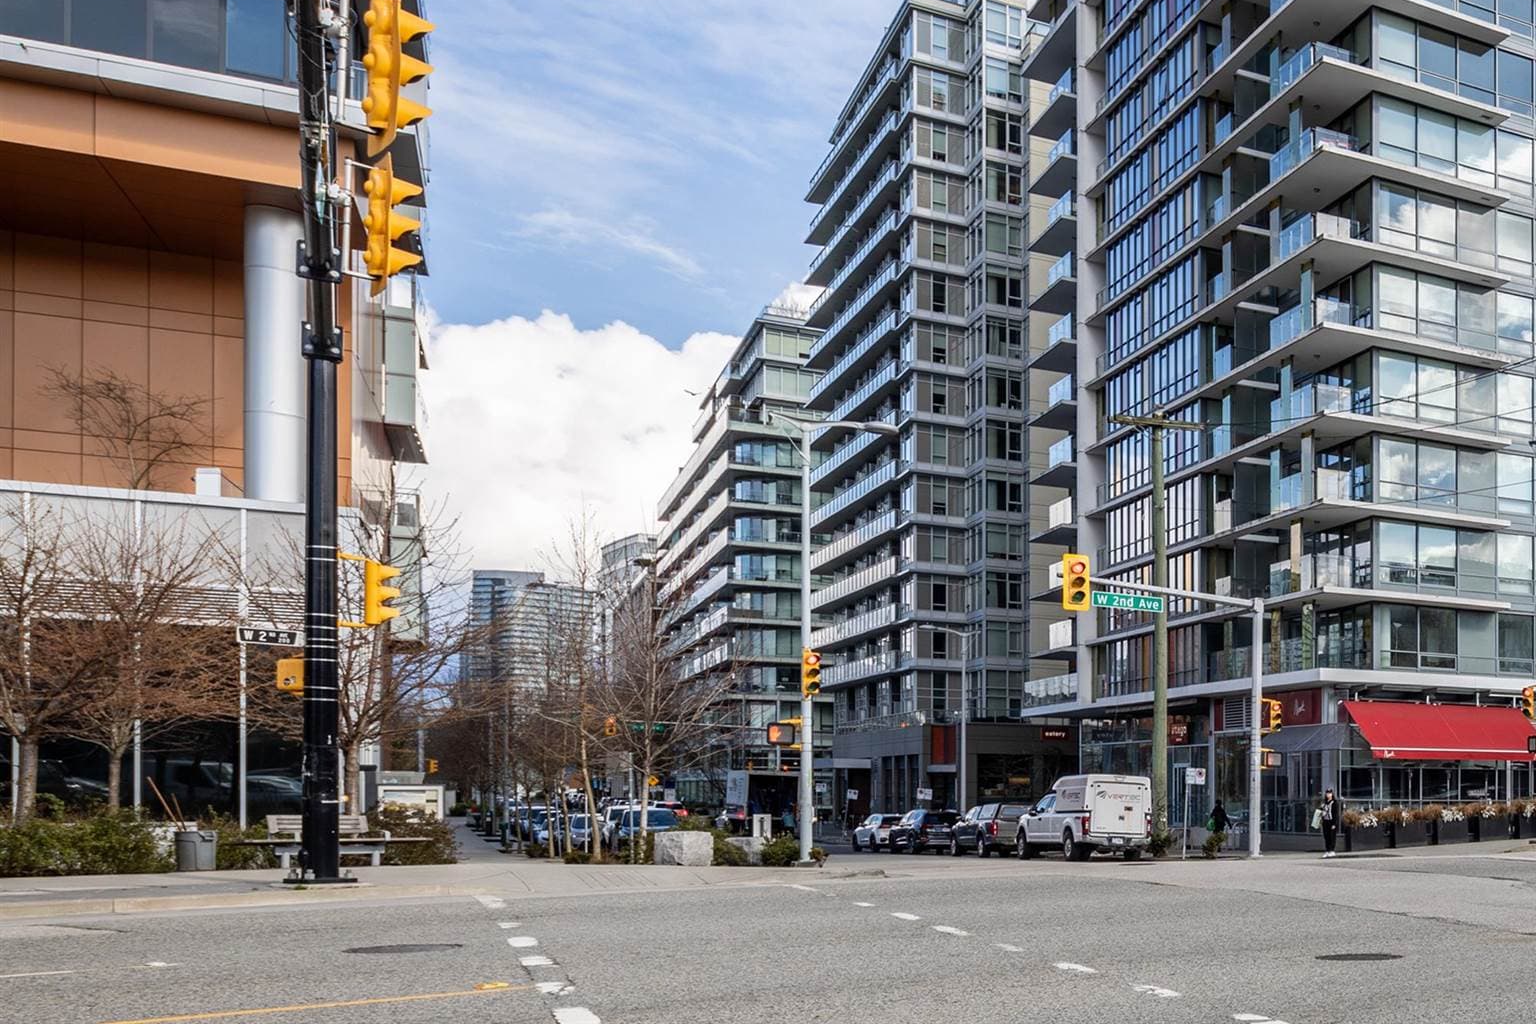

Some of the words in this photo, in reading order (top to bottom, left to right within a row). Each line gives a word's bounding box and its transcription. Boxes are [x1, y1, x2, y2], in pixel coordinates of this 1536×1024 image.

[1097, 594, 1108, 604] W
[1113, 596, 1134, 607] 2nd
[1139, 599, 1159, 609] Ave
[243, 630, 254, 640] W
